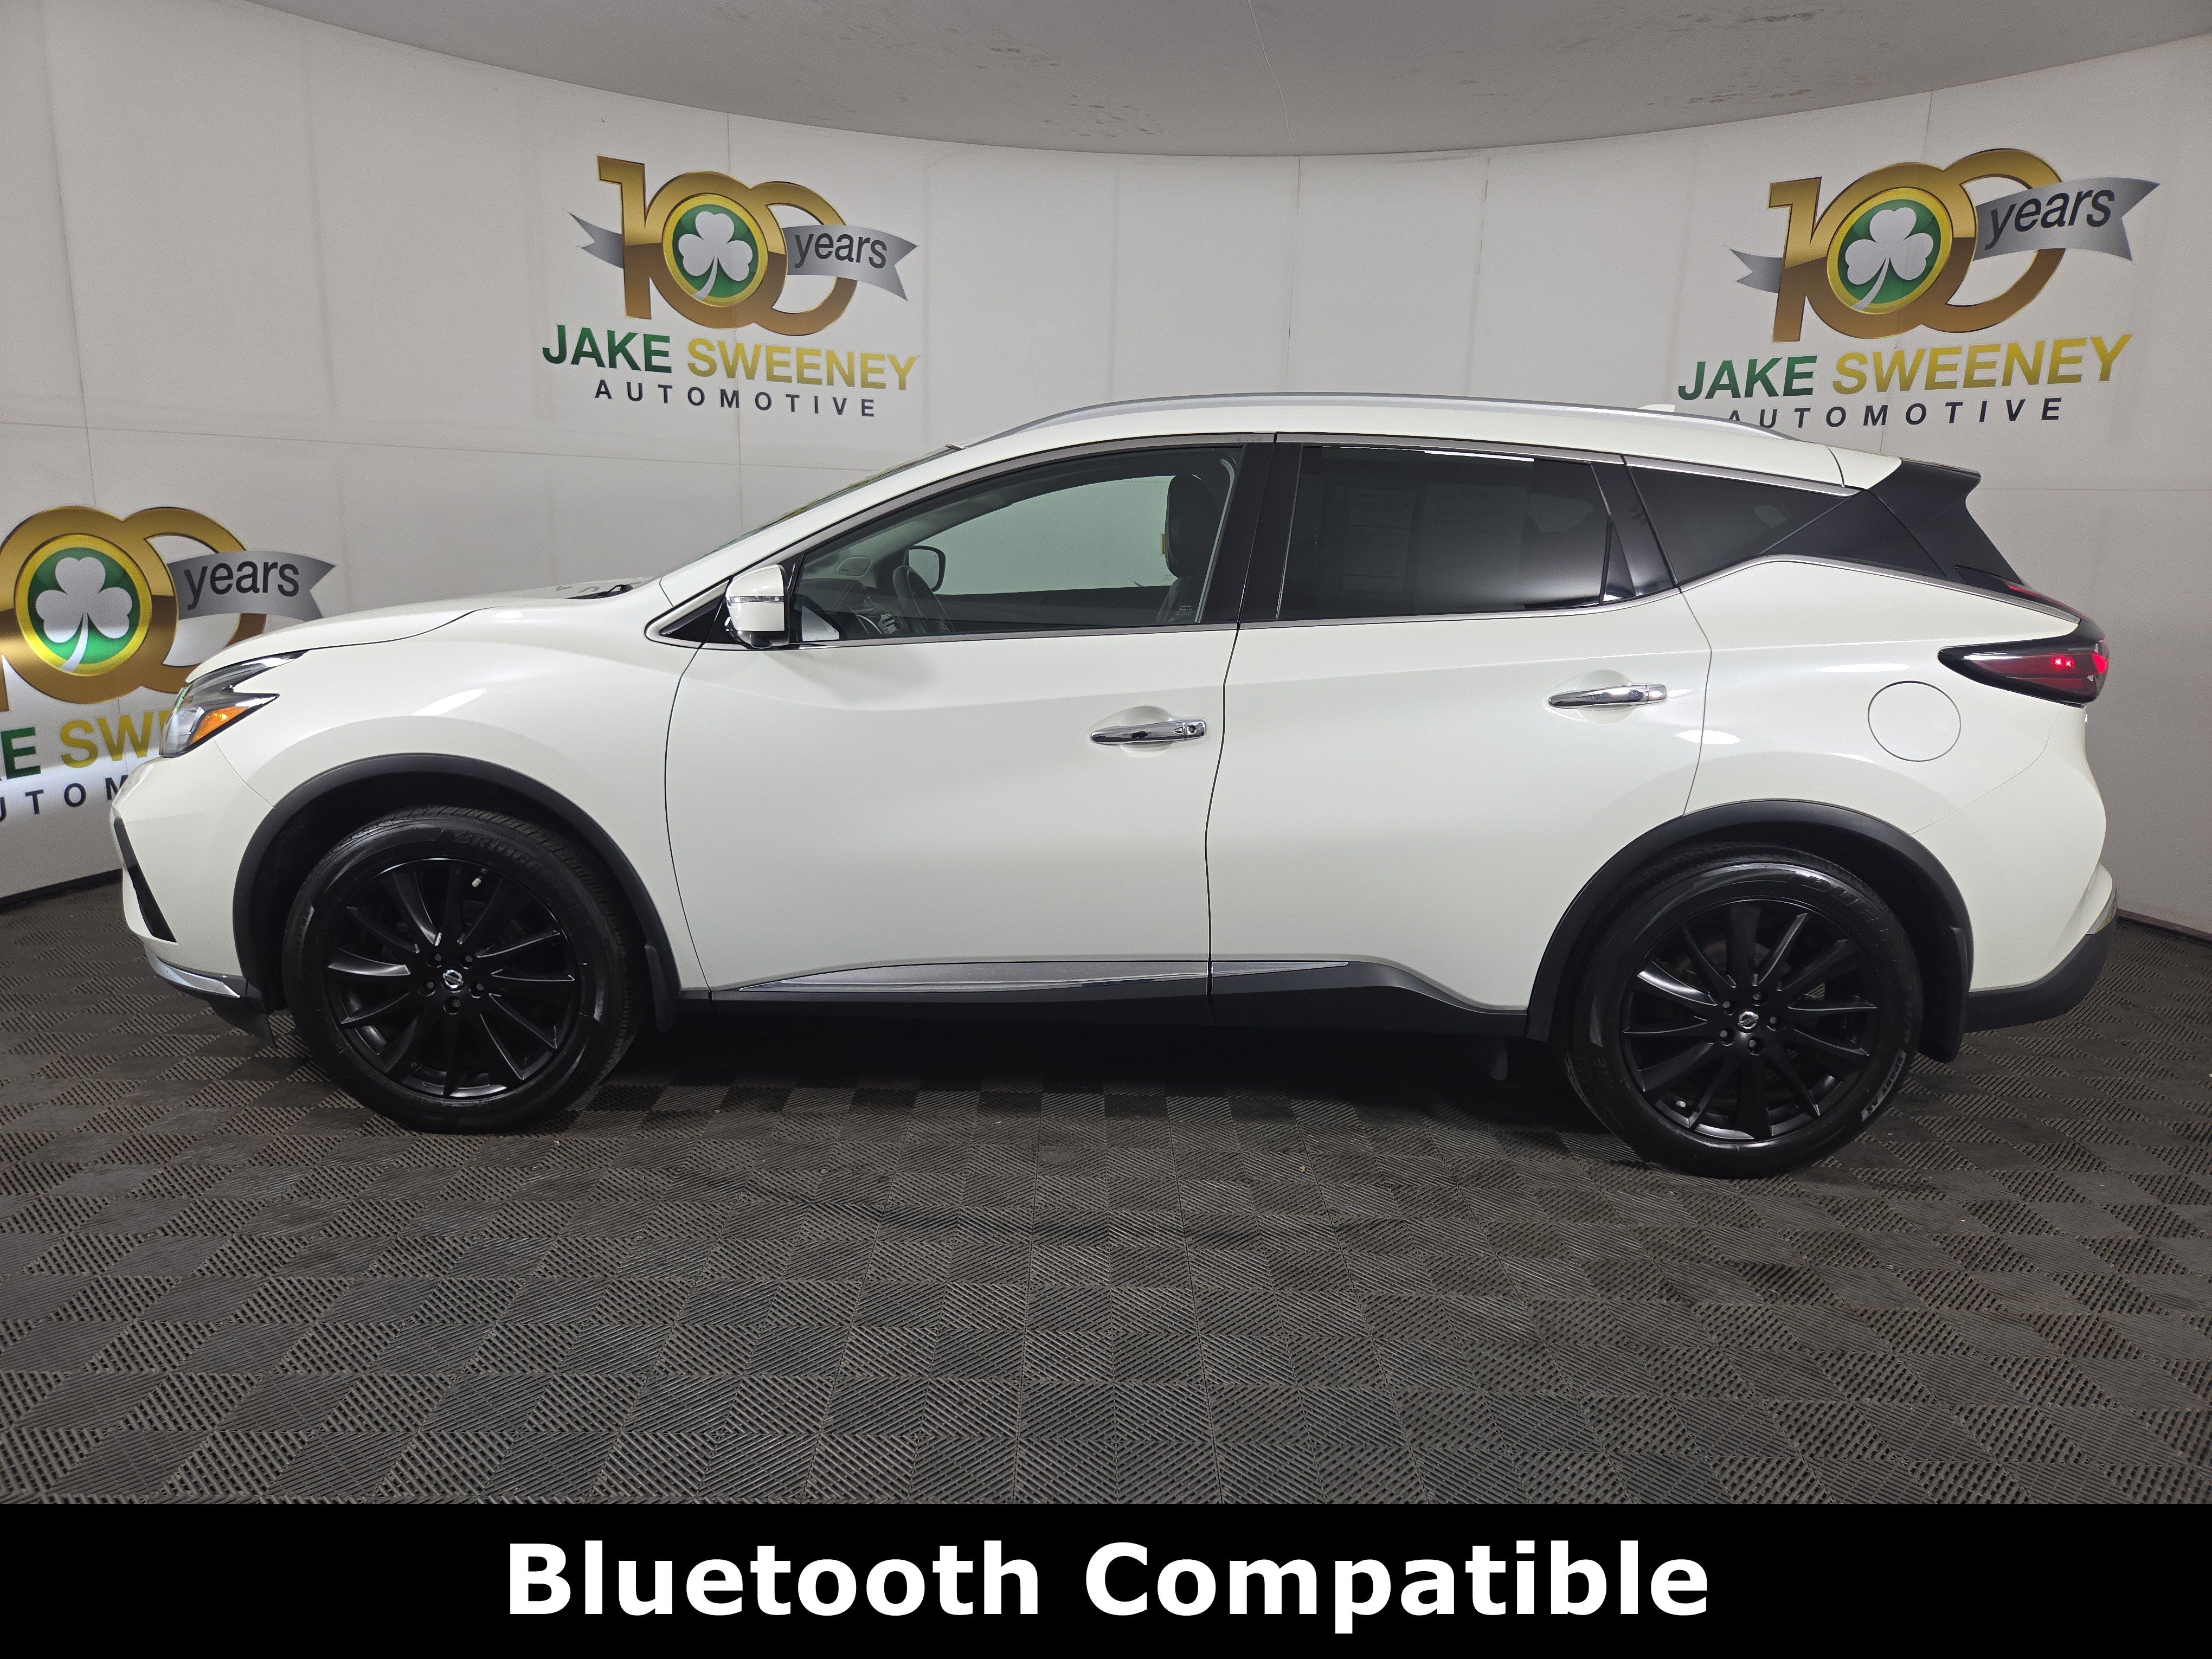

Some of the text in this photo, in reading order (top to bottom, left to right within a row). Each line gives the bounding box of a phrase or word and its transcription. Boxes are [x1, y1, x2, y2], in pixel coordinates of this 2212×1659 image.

[794, 230, 888, 269] years
[1984, 189, 2115, 250] years
[542, 324, 918, 391] JAKE SWEENEY
[1678, 333, 2132, 401] JAKE SWEENEY
[595, 380, 875, 417] AUTOMOTIVE
[0, 505, 267, 712] 00
[184, 561, 299, 610] years
